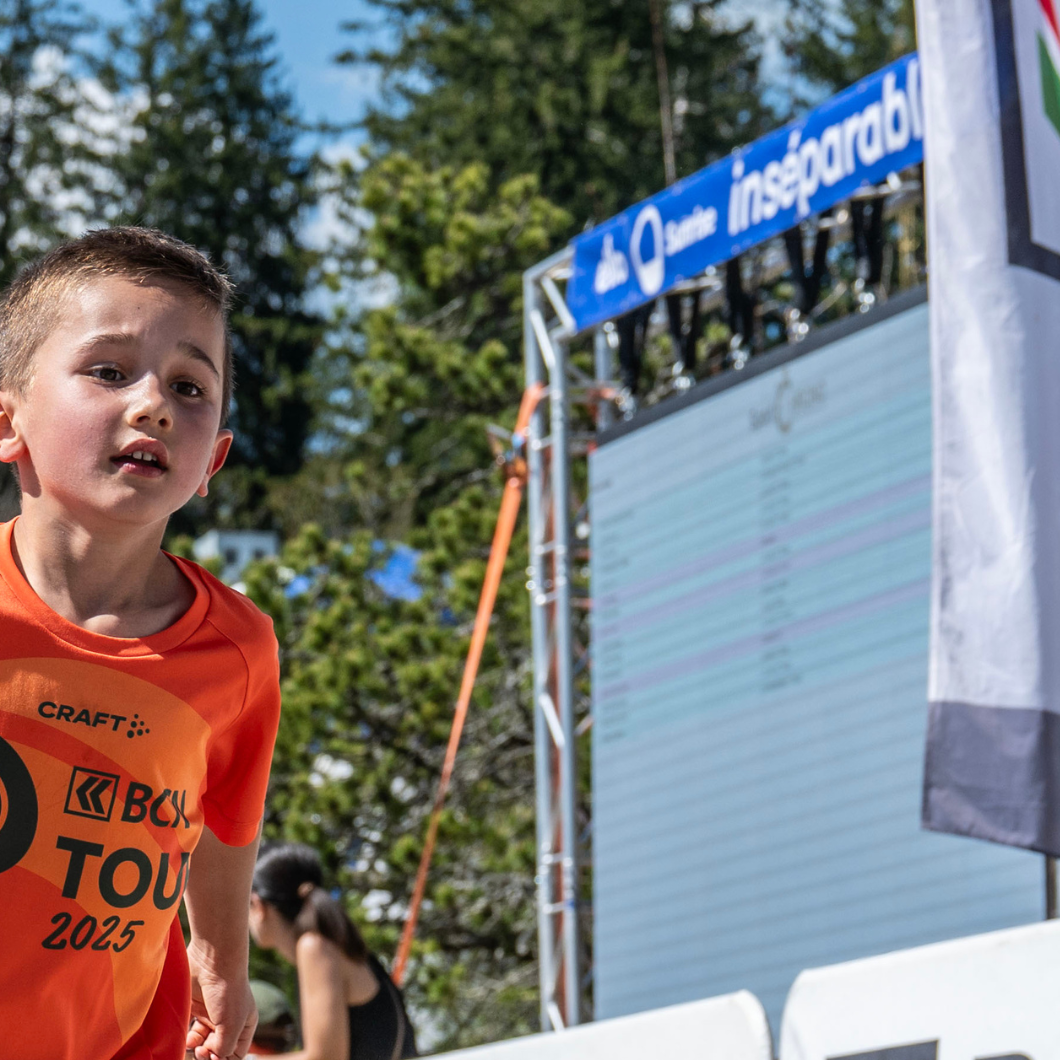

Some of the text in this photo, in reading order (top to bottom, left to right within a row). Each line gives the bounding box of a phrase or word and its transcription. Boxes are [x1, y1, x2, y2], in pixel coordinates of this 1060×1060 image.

[727, 58, 924, 237] inséparabl
[37, 700, 127, 732] CRAFT
[41, 912, 145, 953] 2025
